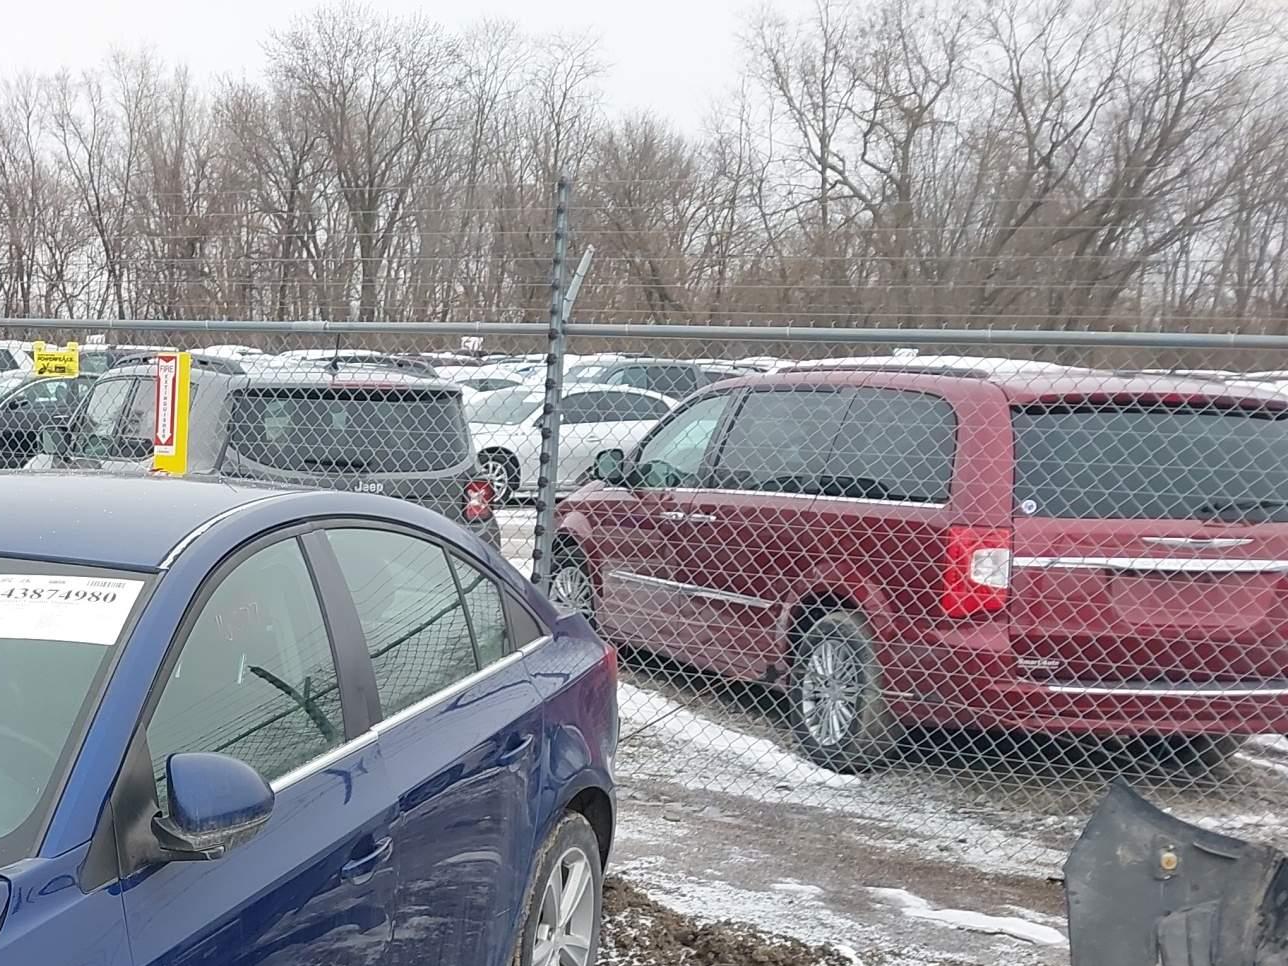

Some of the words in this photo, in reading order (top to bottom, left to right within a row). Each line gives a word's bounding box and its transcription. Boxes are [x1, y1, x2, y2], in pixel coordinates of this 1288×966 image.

[160, 365, 174, 373] FIRE
[354, 480, 384, 493] Jeep
[0, 587, 117, 603] 43874980
